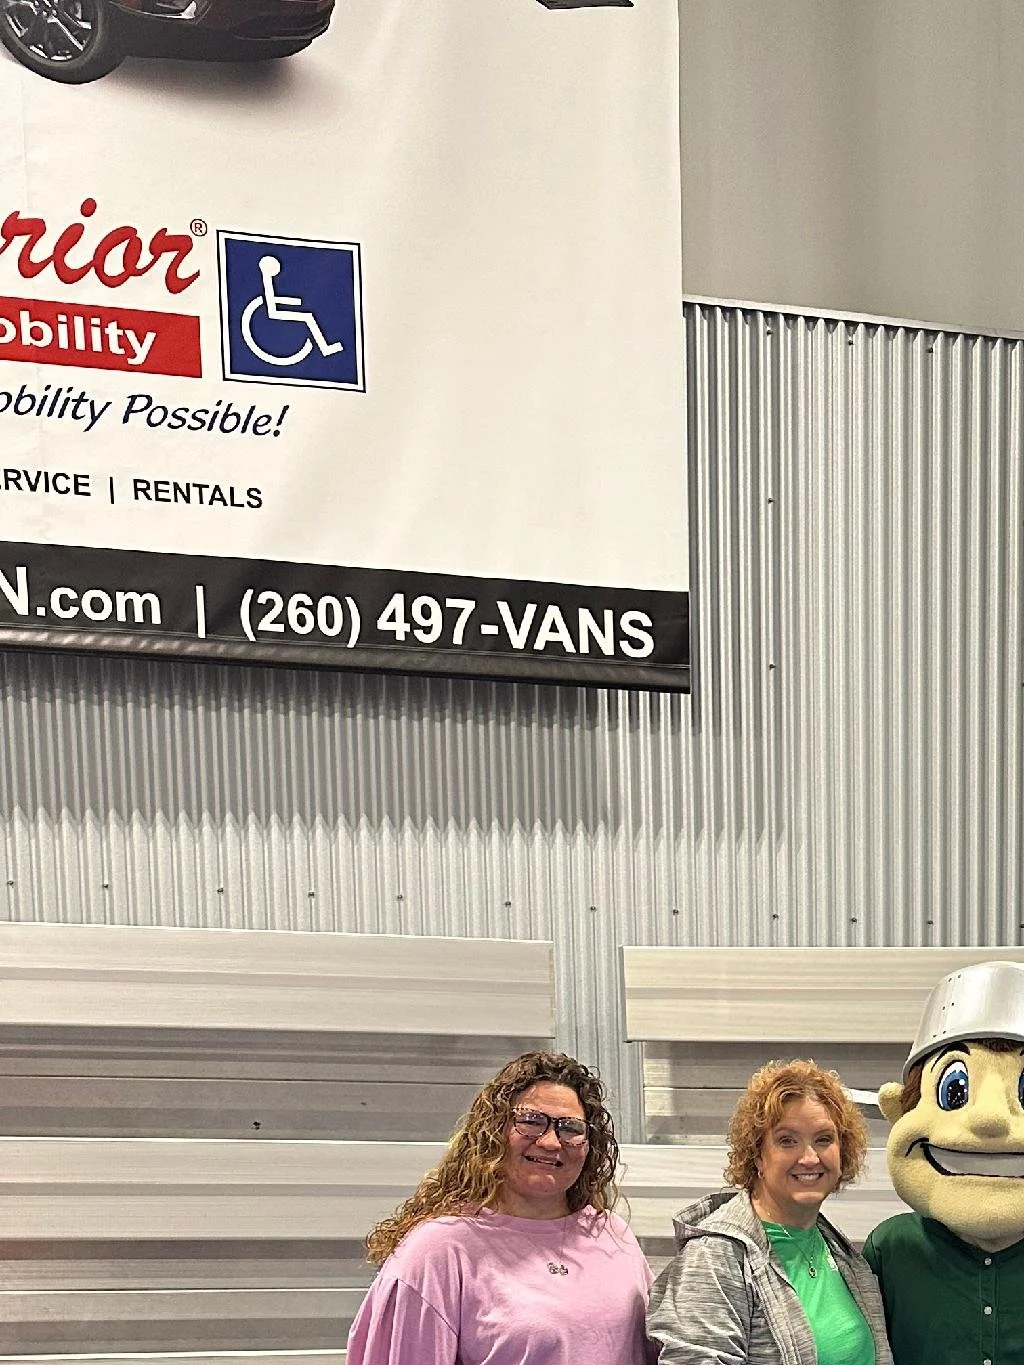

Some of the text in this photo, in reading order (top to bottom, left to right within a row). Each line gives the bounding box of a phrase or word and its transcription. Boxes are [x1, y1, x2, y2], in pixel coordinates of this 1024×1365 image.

[122, 393, 290, 438] Possible!
[0, 468, 91, 497] RVICE
[133, 478, 263, 509] RENTALS
[240, 588, 361, 648] (260)
[376, 592, 656, 659] 497-VANS
